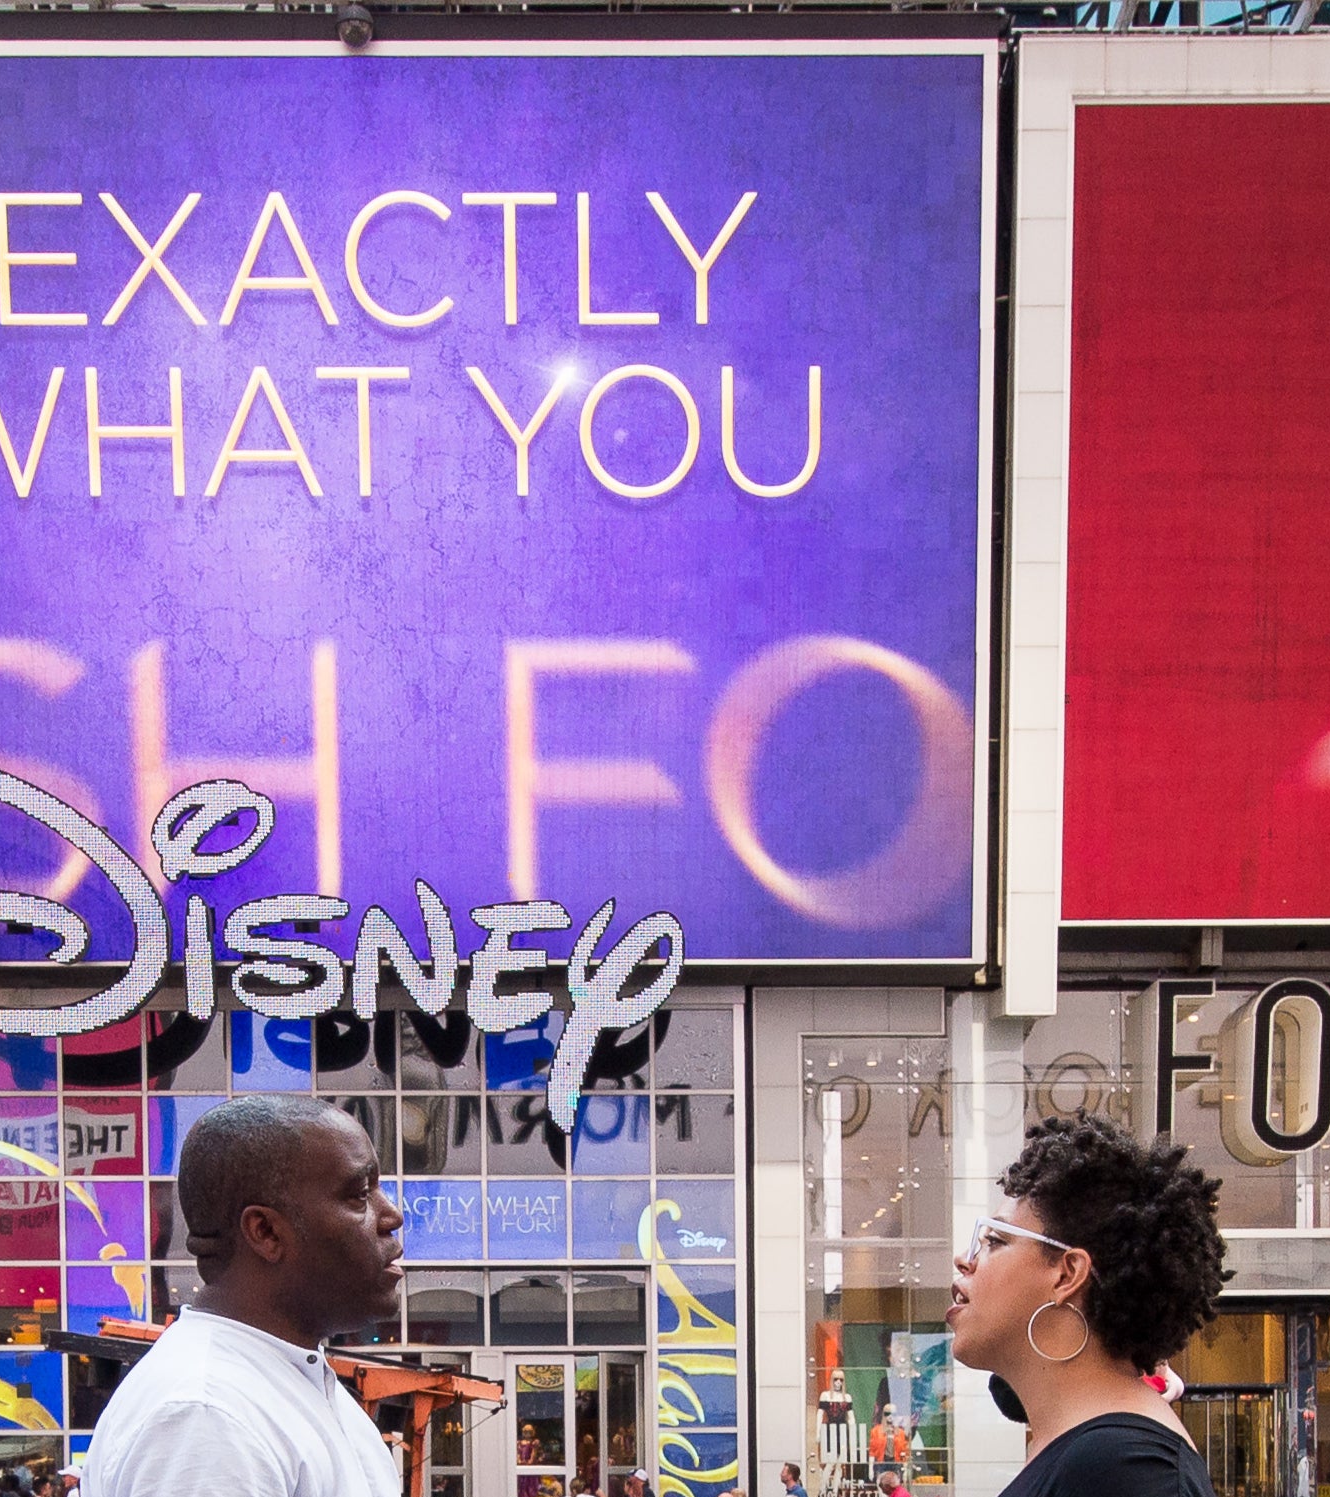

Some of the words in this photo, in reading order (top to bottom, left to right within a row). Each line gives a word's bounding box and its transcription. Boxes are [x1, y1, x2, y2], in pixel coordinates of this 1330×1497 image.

[466, 363, 822, 499] YOU
[487, 1196, 561, 1216] WHAT
[676, 1229, 728, 1253] Disney
